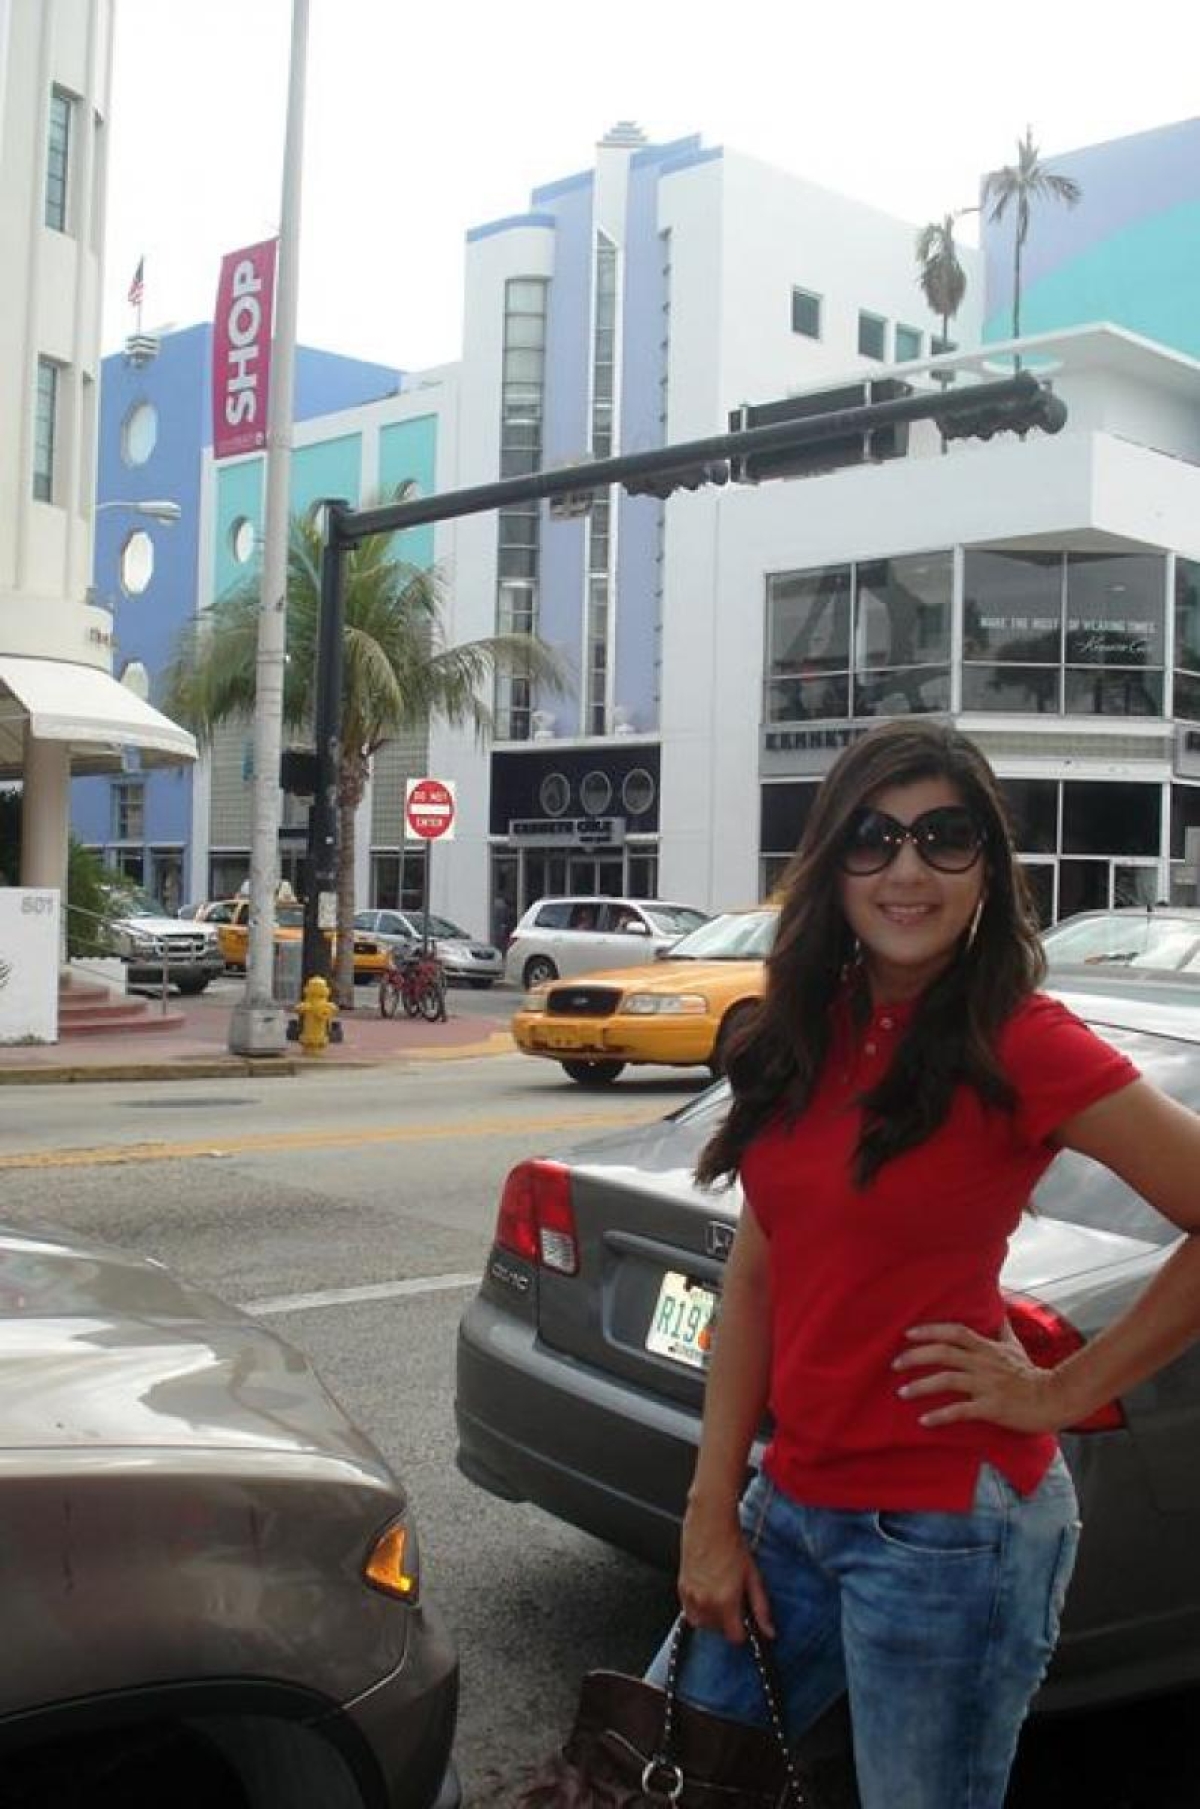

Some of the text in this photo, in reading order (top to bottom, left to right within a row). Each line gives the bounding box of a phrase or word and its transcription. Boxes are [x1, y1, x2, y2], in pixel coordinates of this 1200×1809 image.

[225, 259, 262, 425] SHOP
[765, 728, 870, 750] KENNET
[414, 790, 448, 802] DO NOT
[416, 816, 443, 827] ENTER
[656, 1295, 706, 1343] R19
